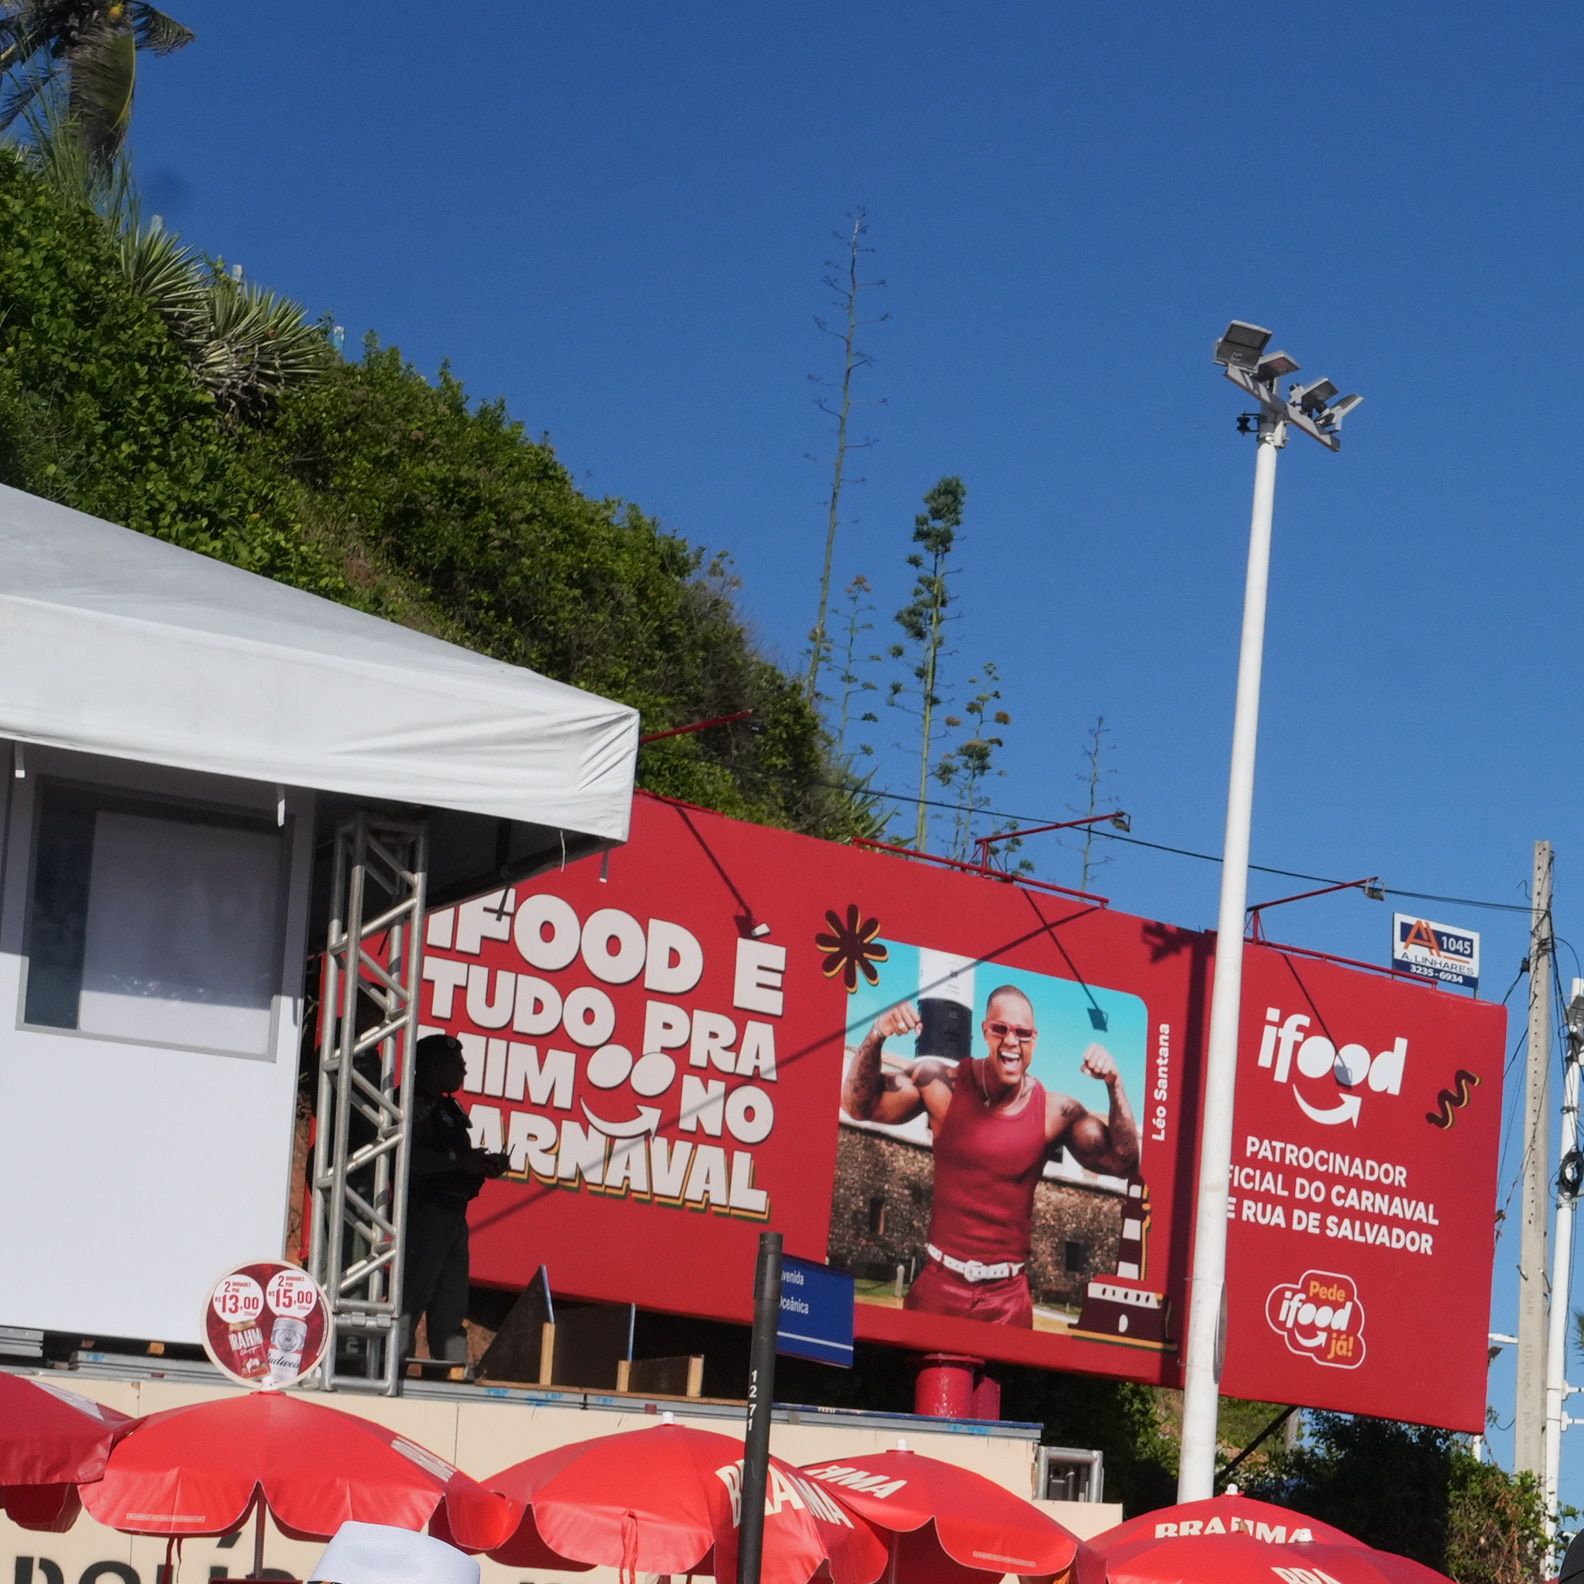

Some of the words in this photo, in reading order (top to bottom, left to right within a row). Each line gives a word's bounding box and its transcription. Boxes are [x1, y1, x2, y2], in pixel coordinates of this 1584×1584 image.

[1441, 935, 1472, 956] 1045
[733, 923, 787, 1016] É
[1415, 954, 1475, 976] LINHARES
[422, 956, 616, 1047] TUDO
[643, 1000, 778, 1082] PRA
[1152, 1023, 1171, 1105] Santana
[1257, 1007, 1408, 1096] ifood
[679, 1074, 774, 1144] NO
[1151, 1109, 1168, 1142] Léo
[466, 1103, 770, 1216] ARNAVAL
[1246, 1136, 1408, 1188] PATROCINADOR
[1295, 1178, 1326, 1203] DO
[1331, 1184, 1440, 1226] CARNAVAL
[1227, 1196, 1237, 1220] E
[1242, 1200, 1287, 1228] RUA
[1292, 1209, 1321, 1234] DE
[1326, 1215, 1434, 1256] SALVADOR
[224, 1281, 231, 1293] 2
[275, 1288, 313, 1309] 15,00
[278, 1275, 285, 1288] 2
[1309, 1280, 1346, 1302] Pede
[221, 1294, 260, 1315] 13,00
[780, 1296, 809, 1315] ceânica
[1279, 1290, 1353, 1331] ifood
[1327, 1332, 1355, 1361] já!
